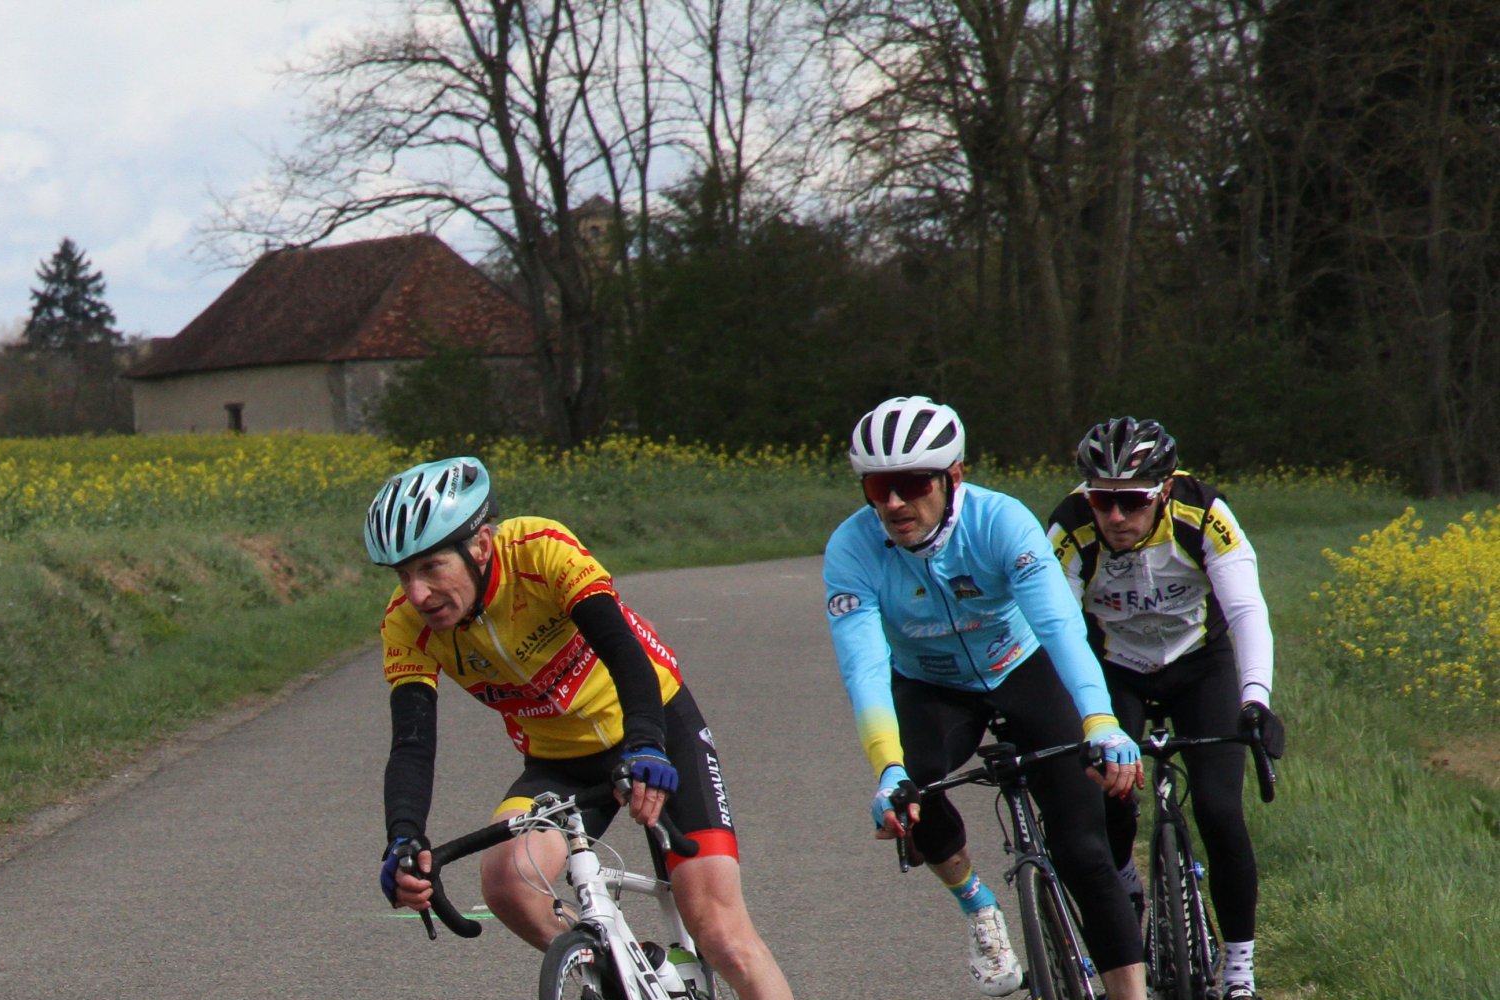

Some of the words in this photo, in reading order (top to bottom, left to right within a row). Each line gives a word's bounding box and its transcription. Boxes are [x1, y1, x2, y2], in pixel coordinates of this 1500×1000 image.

[516, 703, 555, 720] Ainay
[707, 753, 732, 828] RENAULT
[1013, 796, 1031, 843] LOOK
